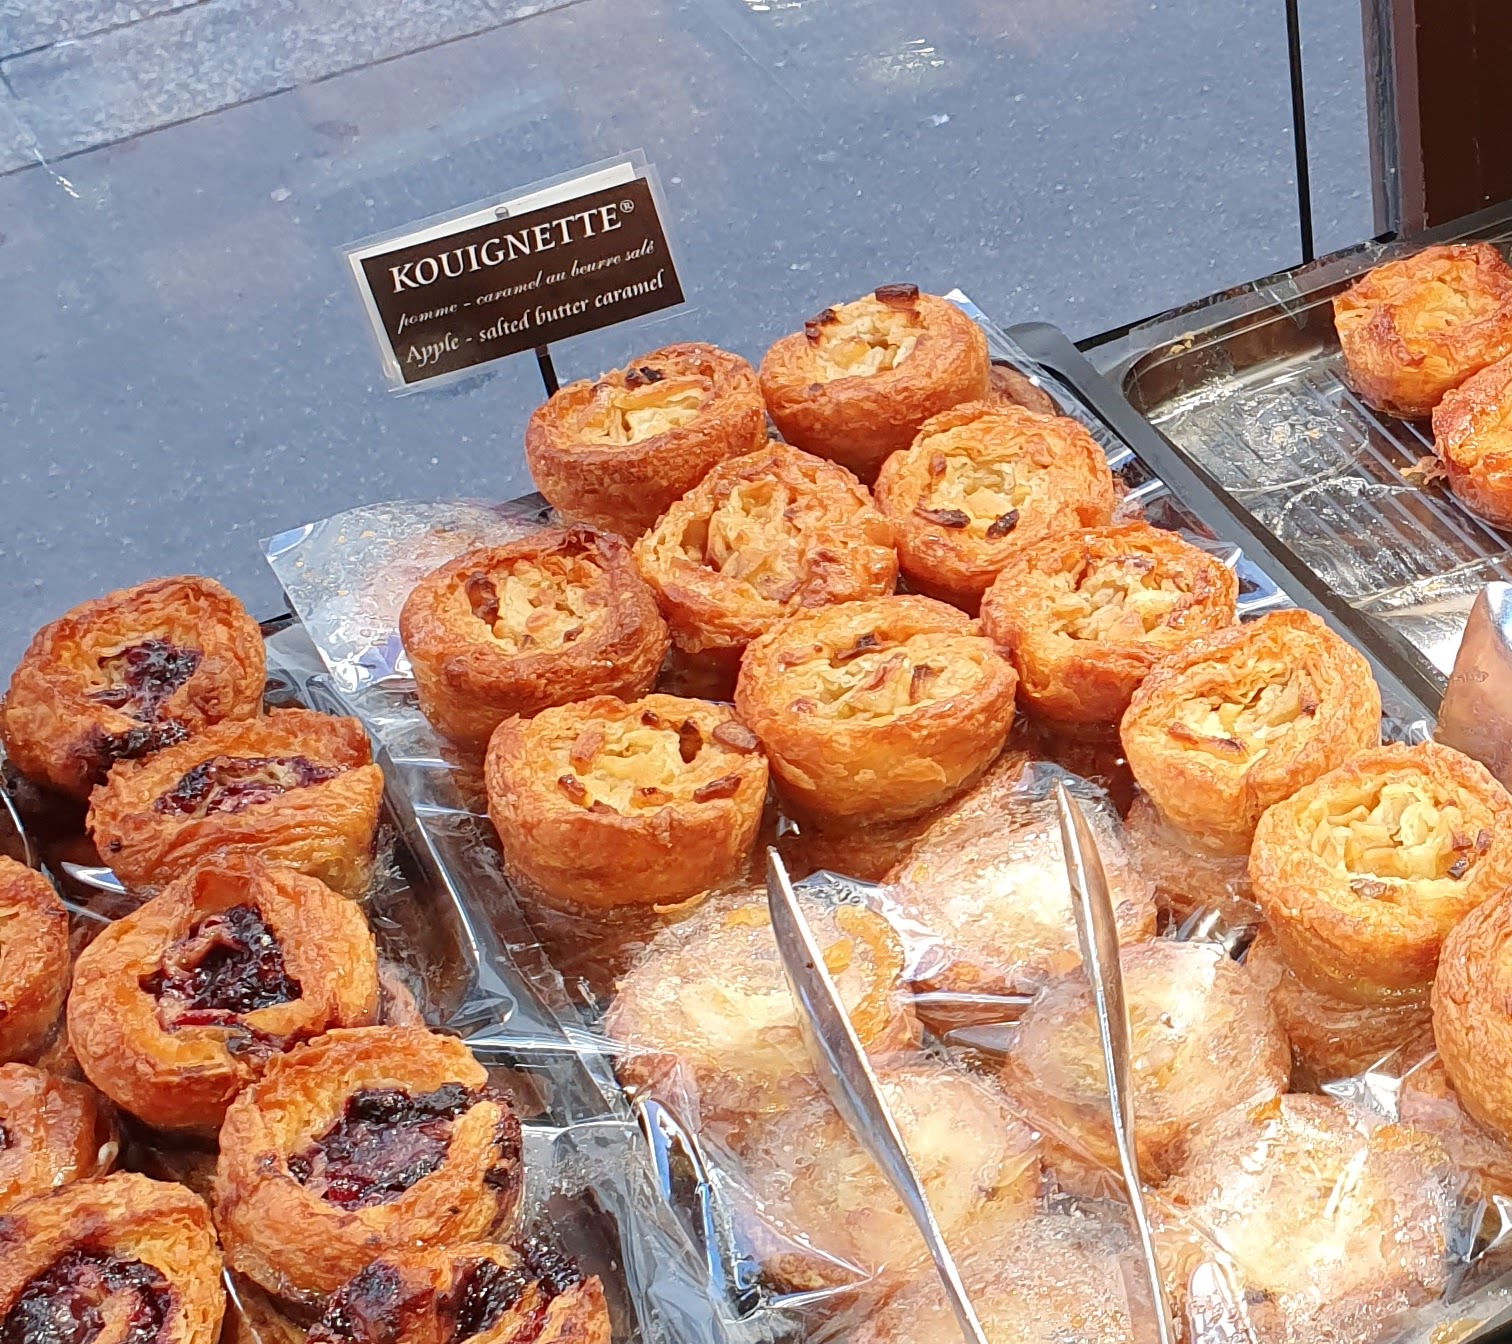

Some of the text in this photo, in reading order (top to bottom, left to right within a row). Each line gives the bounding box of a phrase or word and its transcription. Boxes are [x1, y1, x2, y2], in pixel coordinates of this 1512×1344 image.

[397, 302, 459, 335] pomme
[475, 269, 544, 306] caramel
[546, 271, 568, 286] au
[570, 256, 622, 279] beurre
[624, 238, 656, 263] salé
[405, 333, 461, 369] Apple
[478, 311, 530, 343] salted
[535, 298, 590, 327] butter
[594, 268, 666, 309] caramel
